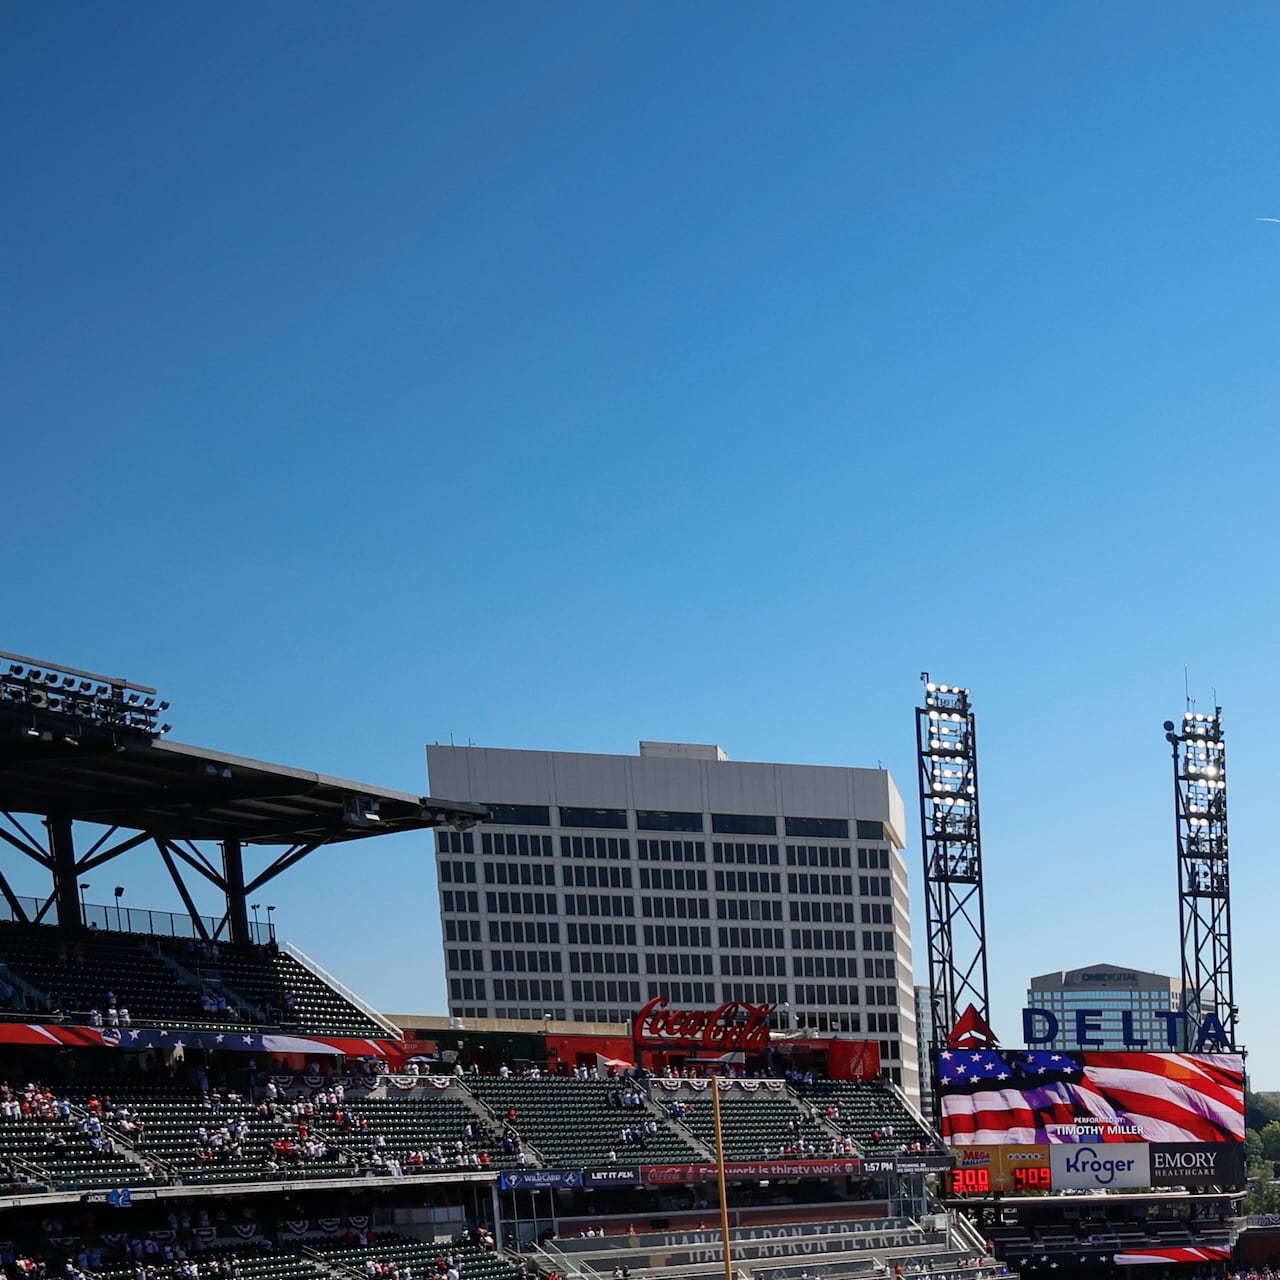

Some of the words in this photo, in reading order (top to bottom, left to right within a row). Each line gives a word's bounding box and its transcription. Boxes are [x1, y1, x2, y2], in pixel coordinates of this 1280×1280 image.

[633, 996, 778, 1051] Coca-Cola
[1022, 1008, 1231, 1051] DELTA
[1073, 1116, 1114, 1124] PERFORMED
[1056, 1124, 1106, 1136] TIMOTHY
[1107, 1124, 1144, 1135] MILLER
[771, 1163, 810, 1175] thirsty
[816, 1162, 841, 1173] work
[864, 1162, 880, 1171] 1:57
[881, 1162, 893, 1171] PM
[1066, 1147, 1135, 1185] Kroger
[1154, 1152, 1217, 1169] EMORY
[952, 1169, 988, 1185] 300
[1016, 1168, 1051, 1184] 409
[1155, 1168, 1216, 1176] HEALTHCARE
[107, 1188, 132, 1207] 42
